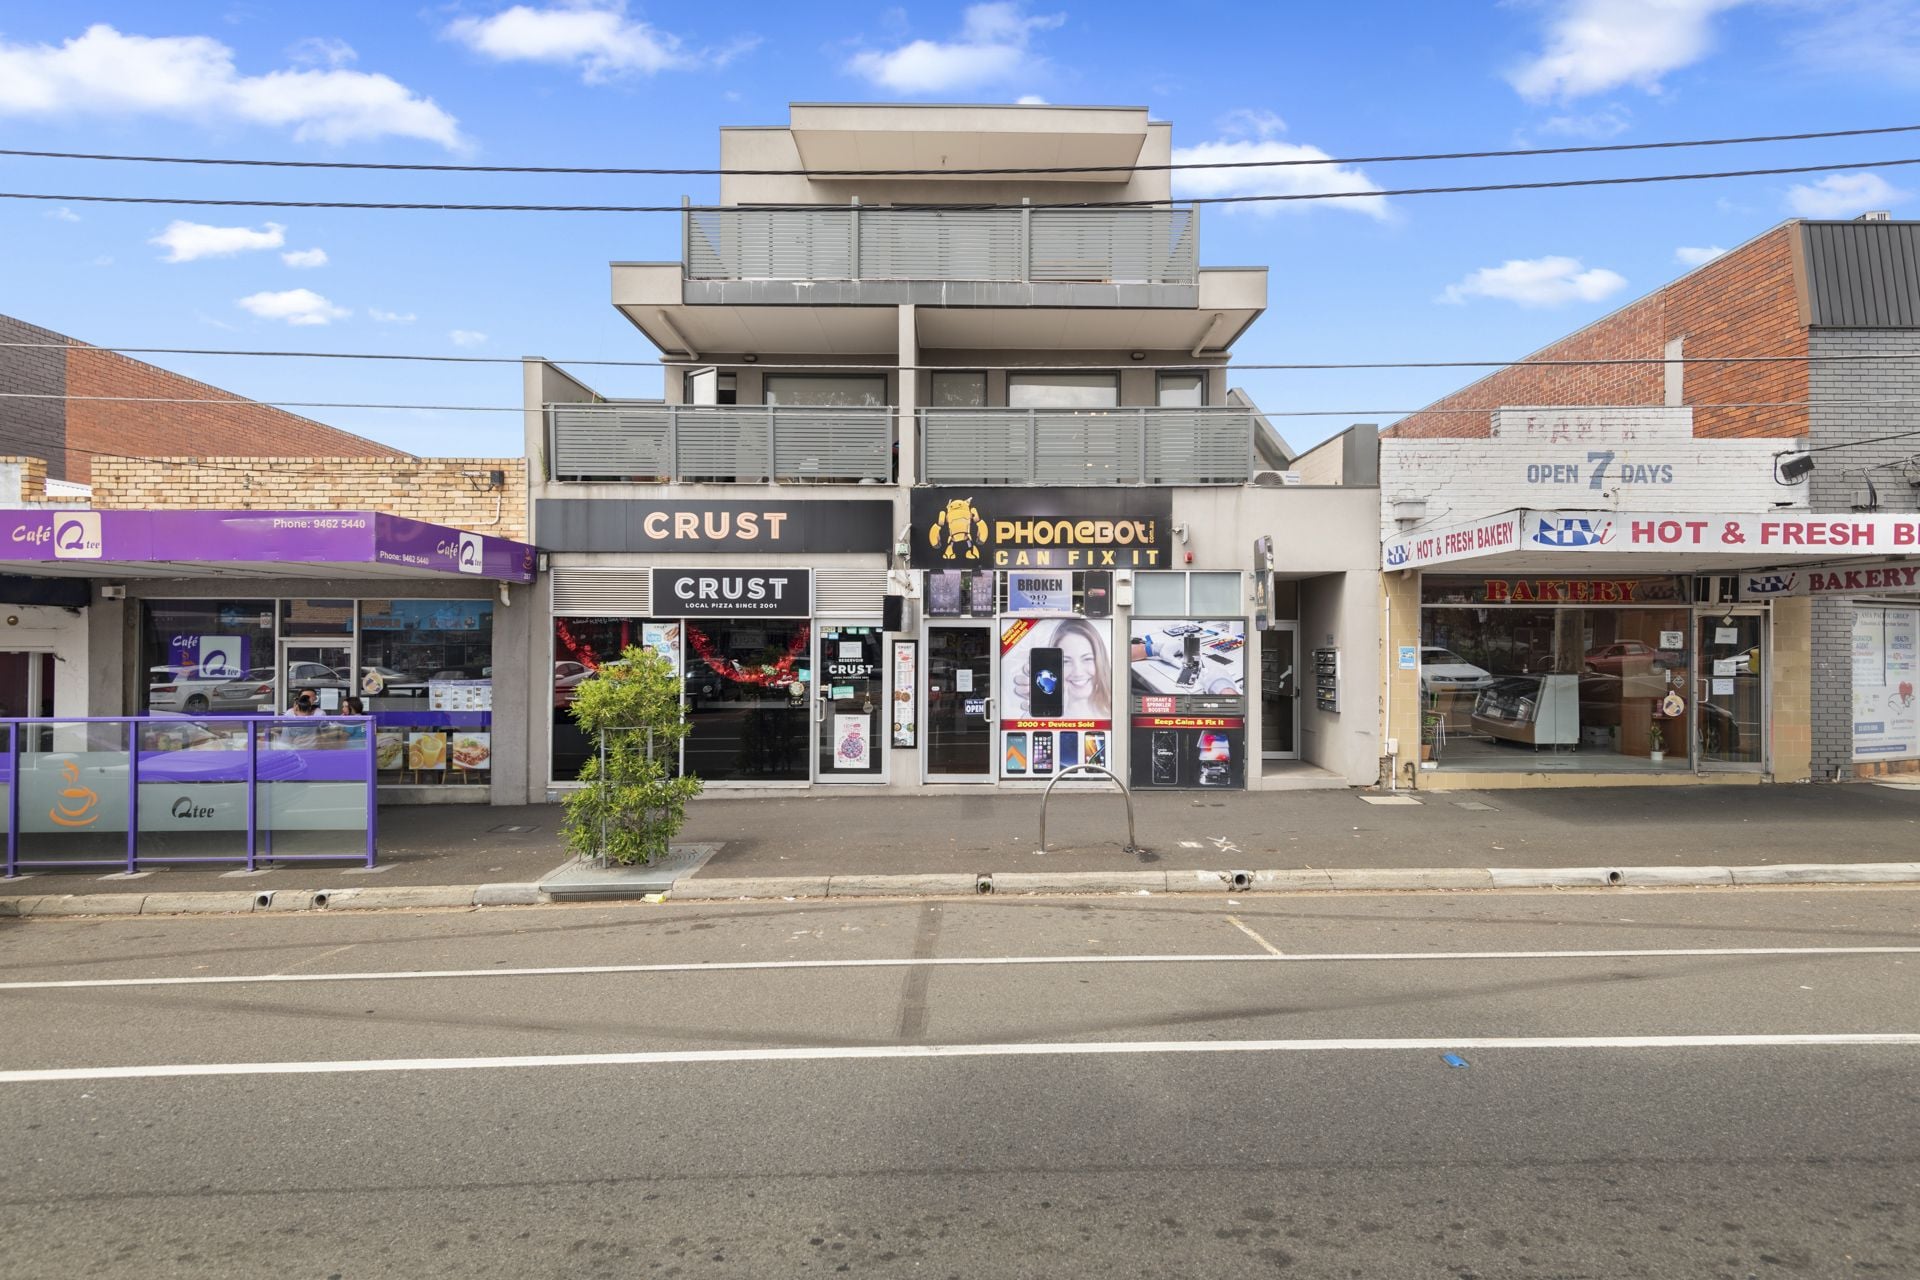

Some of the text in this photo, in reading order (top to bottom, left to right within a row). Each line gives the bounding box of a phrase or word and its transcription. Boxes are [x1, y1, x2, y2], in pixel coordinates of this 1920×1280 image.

[1527, 452, 1673, 490] OPEN 7 DAYS
[273, 519, 366, 529] Phone: 9462 5440
[643, 511, 788, 541] CRUST
[1632, 520, 1710, 545] HOT
[1720, 522, 1747, 544] &
[1760, 523, 1875, 546] FRESH
[1893, 523, 1920, 545] B
[12, 525, 52, 546] Café
[1417, 538, 1434, 560] HOT
[1436, 537, 1442, 556] &
[1445, 529, 1474, 555] FRESH
[1477, 521, 1514, 550] BAKERY
[379, 550, 402, 562] Phone:
[436, 540, 458, 560] Café
[995, 550, 1159, 566] CAN FIX IT
[674, 577, 788, 600] CRUST
[1017, 578, 1063, 592] BROKEN
[1808, 567, 1920, 592] BAKERY
[1484, 580, 1638, 602] BAKERY
[173, 635, 199, 649] Café
[828, 664, 874, 675] CRUST
[966, 704, 984, 713] OPEN
[1175, 718, 1195, 726] Calm
[172, 796, 216, 818] Qtee
